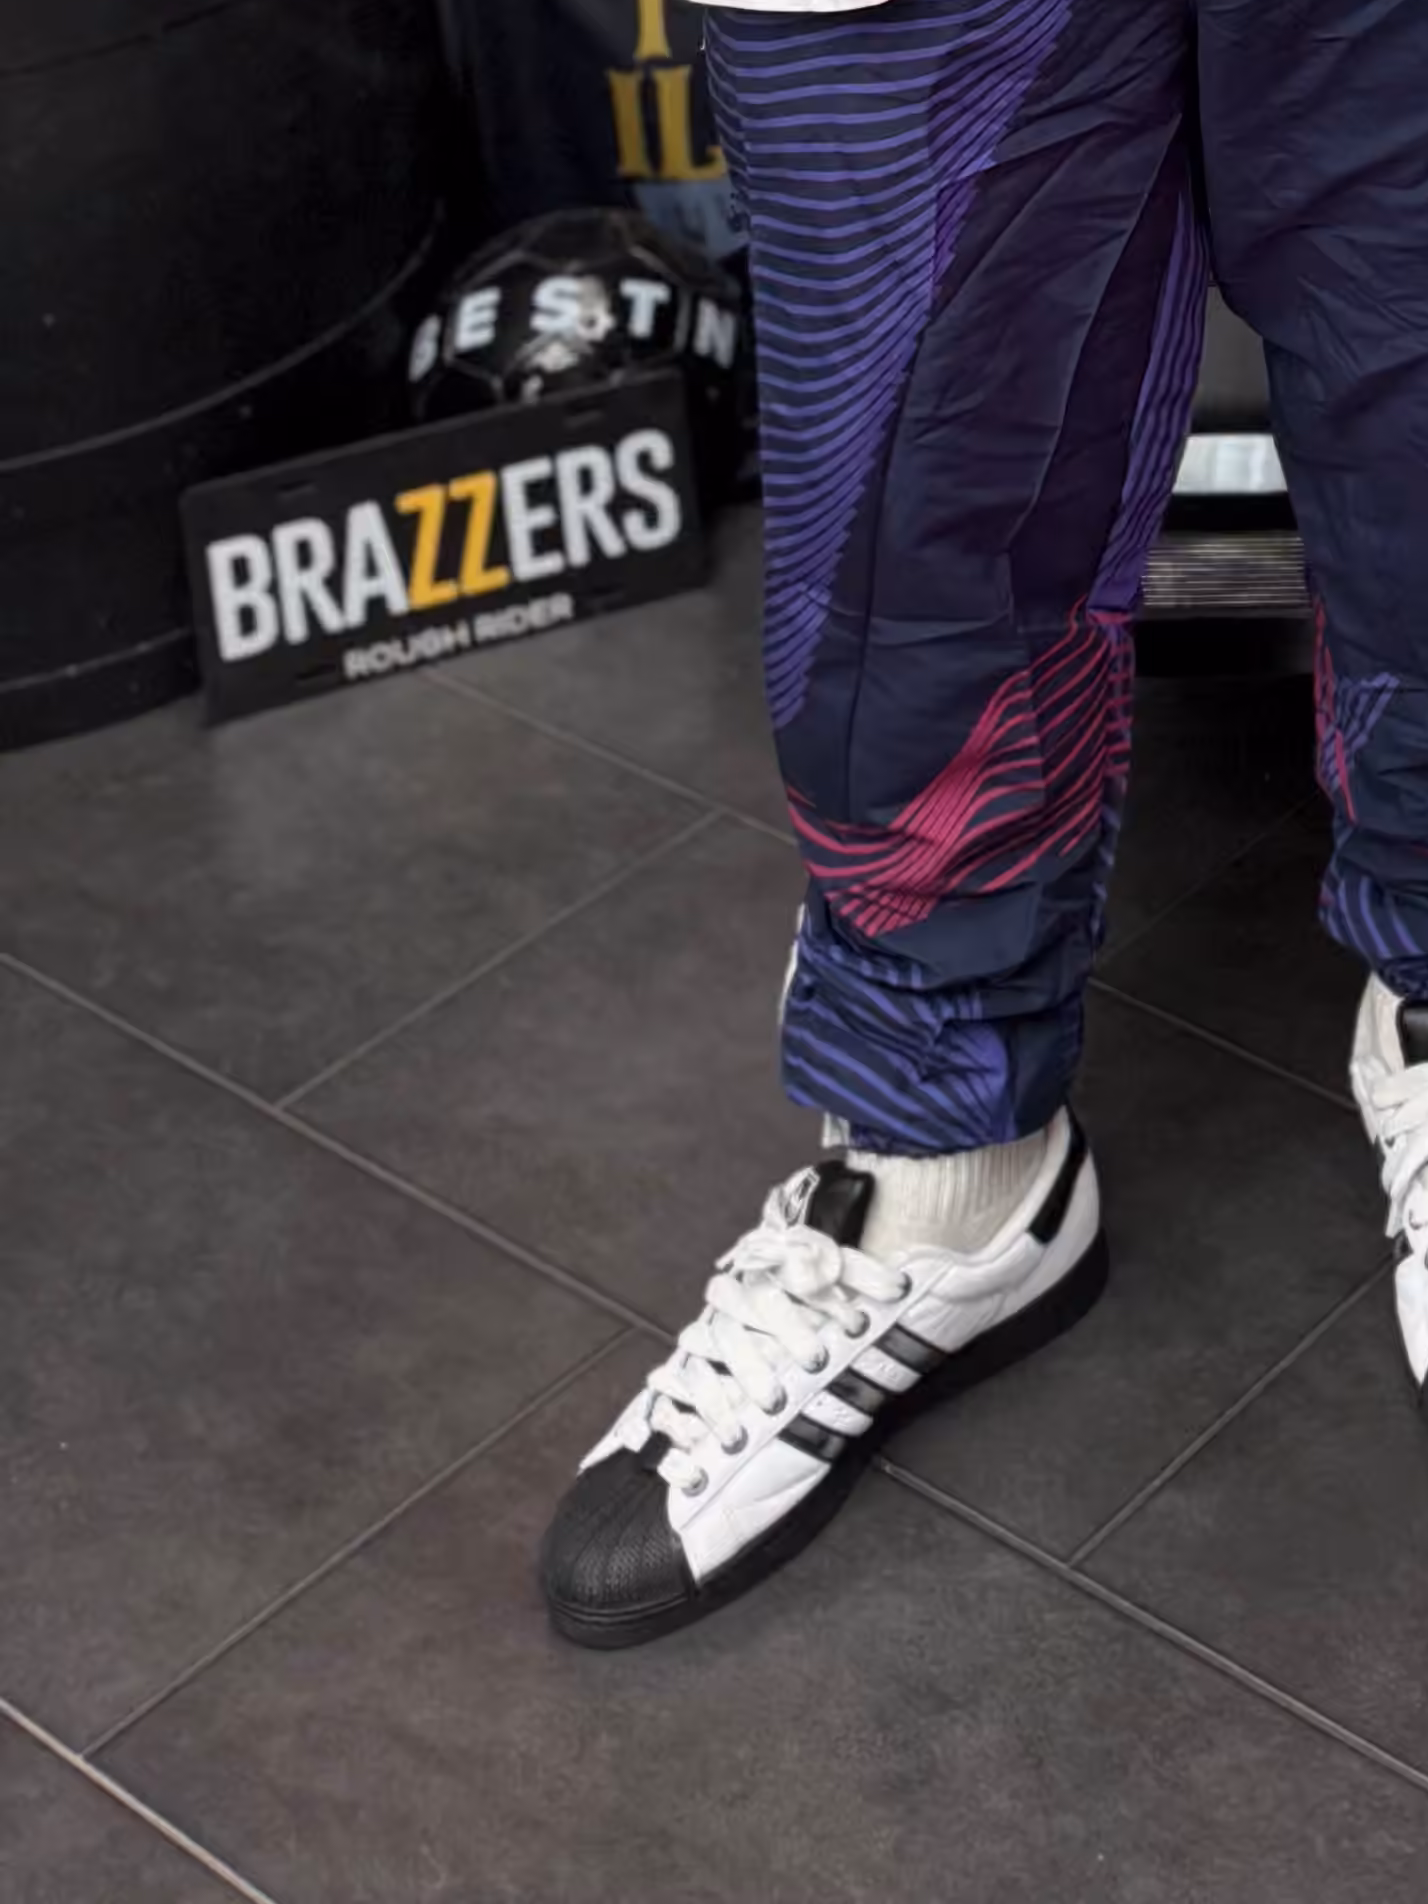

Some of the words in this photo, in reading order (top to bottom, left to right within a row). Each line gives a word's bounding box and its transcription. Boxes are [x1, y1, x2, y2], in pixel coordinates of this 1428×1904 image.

[205, 429, 682, 662] BRAZZERS
[344, 621, 472, 678] ROUGH
[474, 592, 575, 643] RIDER
